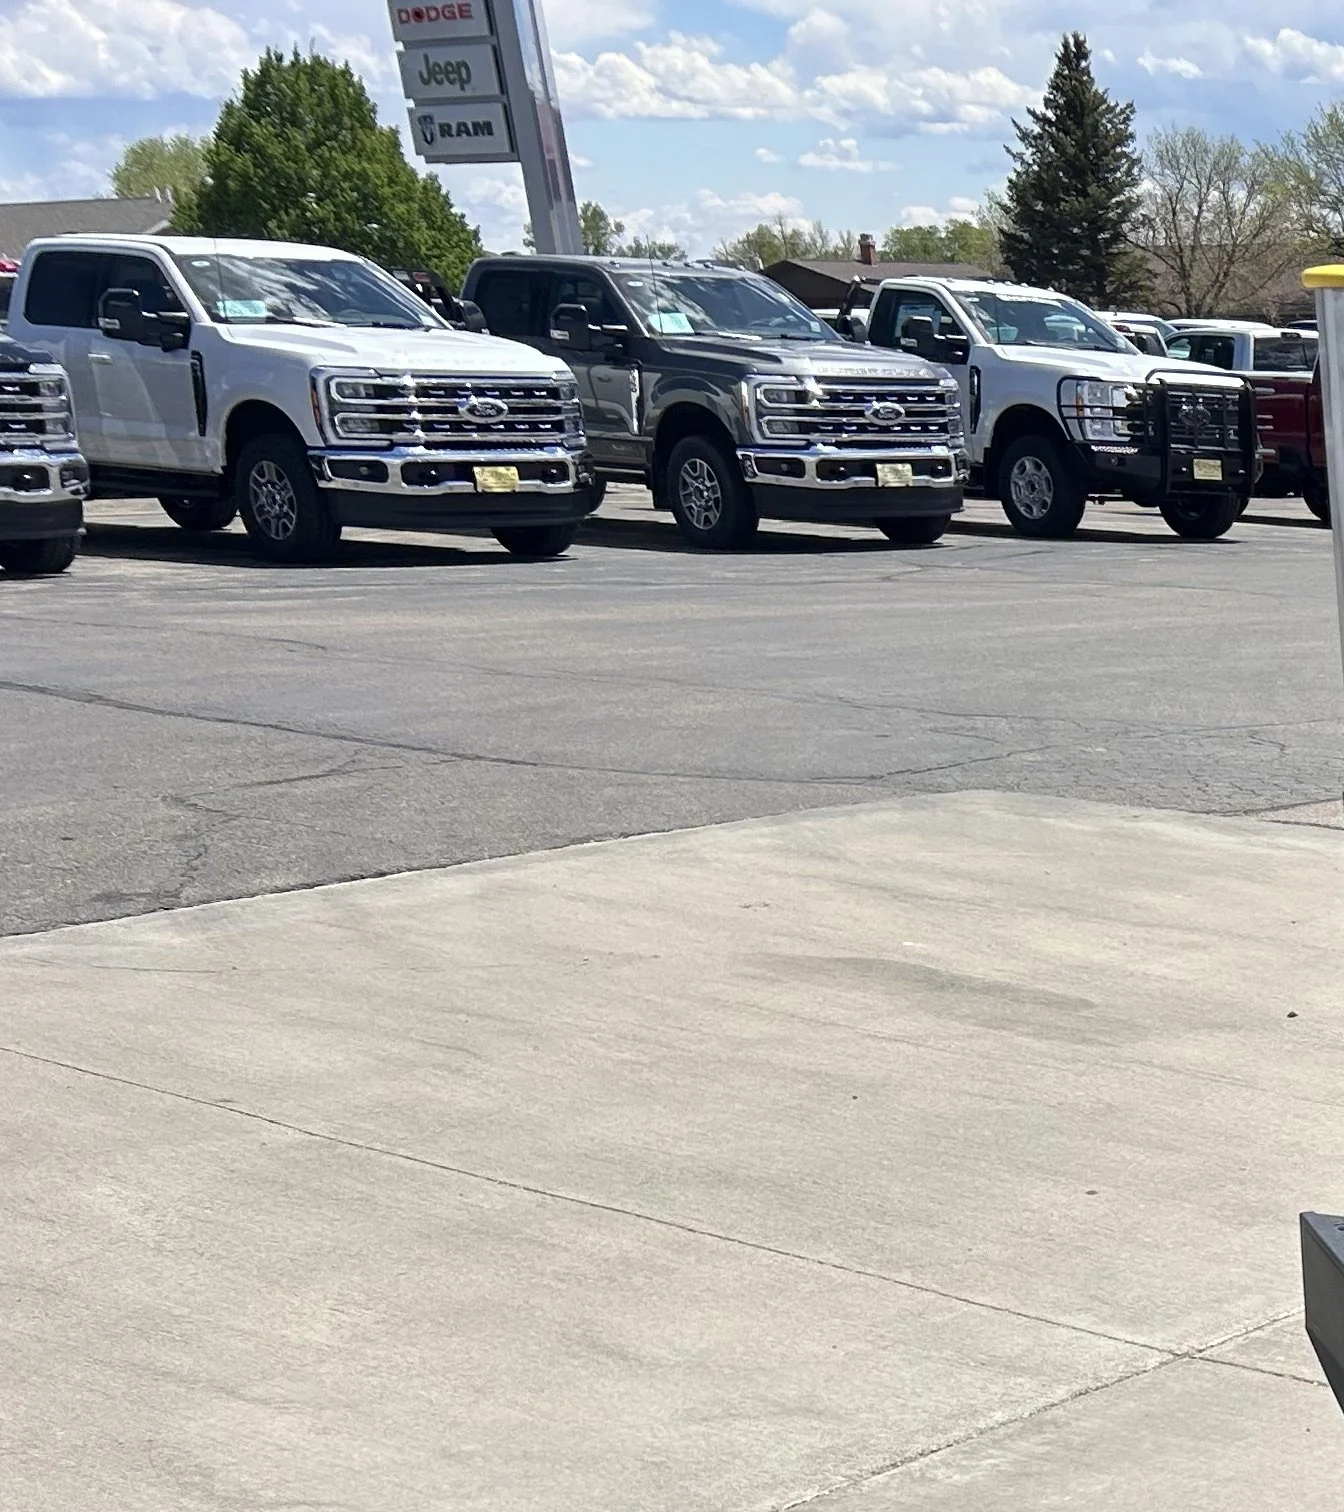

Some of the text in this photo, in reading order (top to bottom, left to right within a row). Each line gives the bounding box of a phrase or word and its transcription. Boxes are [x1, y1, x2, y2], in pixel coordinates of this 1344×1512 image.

[397, 2, 473, 24] DODGE
[418, 53, 472, 91] Jeep
[439, 120, 494, 138] RAM
